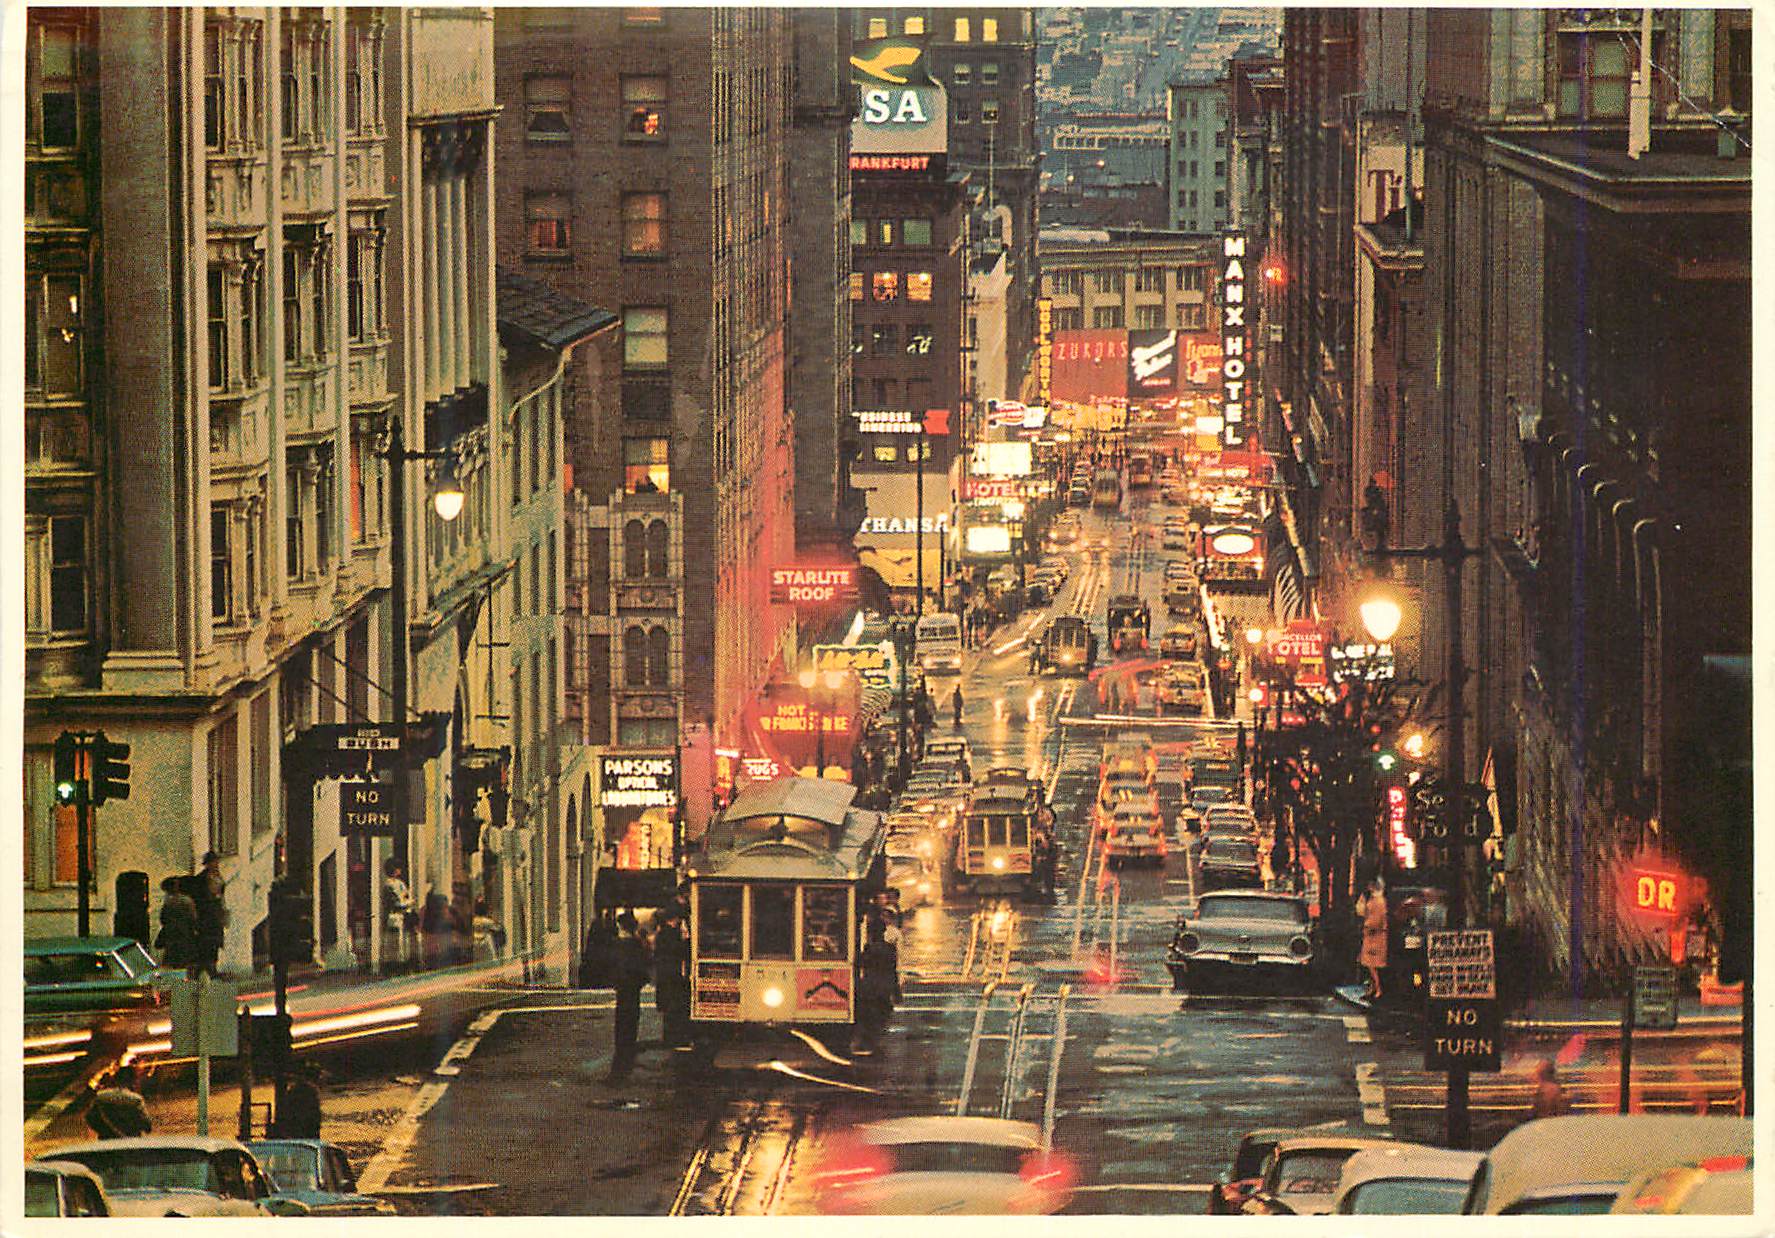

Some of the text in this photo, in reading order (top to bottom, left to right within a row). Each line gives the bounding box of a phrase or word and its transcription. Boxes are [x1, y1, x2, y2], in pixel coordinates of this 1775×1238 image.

[865, 90, 927, 123] SA
[849, 157, 929, 170] RANKFURT
[1224, 237, 1245, 326] MANX
[1057, 340, 1129, 361] ZUKORS
[1224, 337, 1245, 445] HOTEL
[773, 570, 849, 585] STARLITE
[789, 587, 835, 601] ROOF
[604, 760, 673, 776] PARSONS
[355, 790, 379, 803] NO
[347, 812, 390, 825] TURN
[1638, 876, 1676, 911] DR
[1447, 1009, 1477, 1025] NO
[1435, 1039, 1492, 1055] TURN
